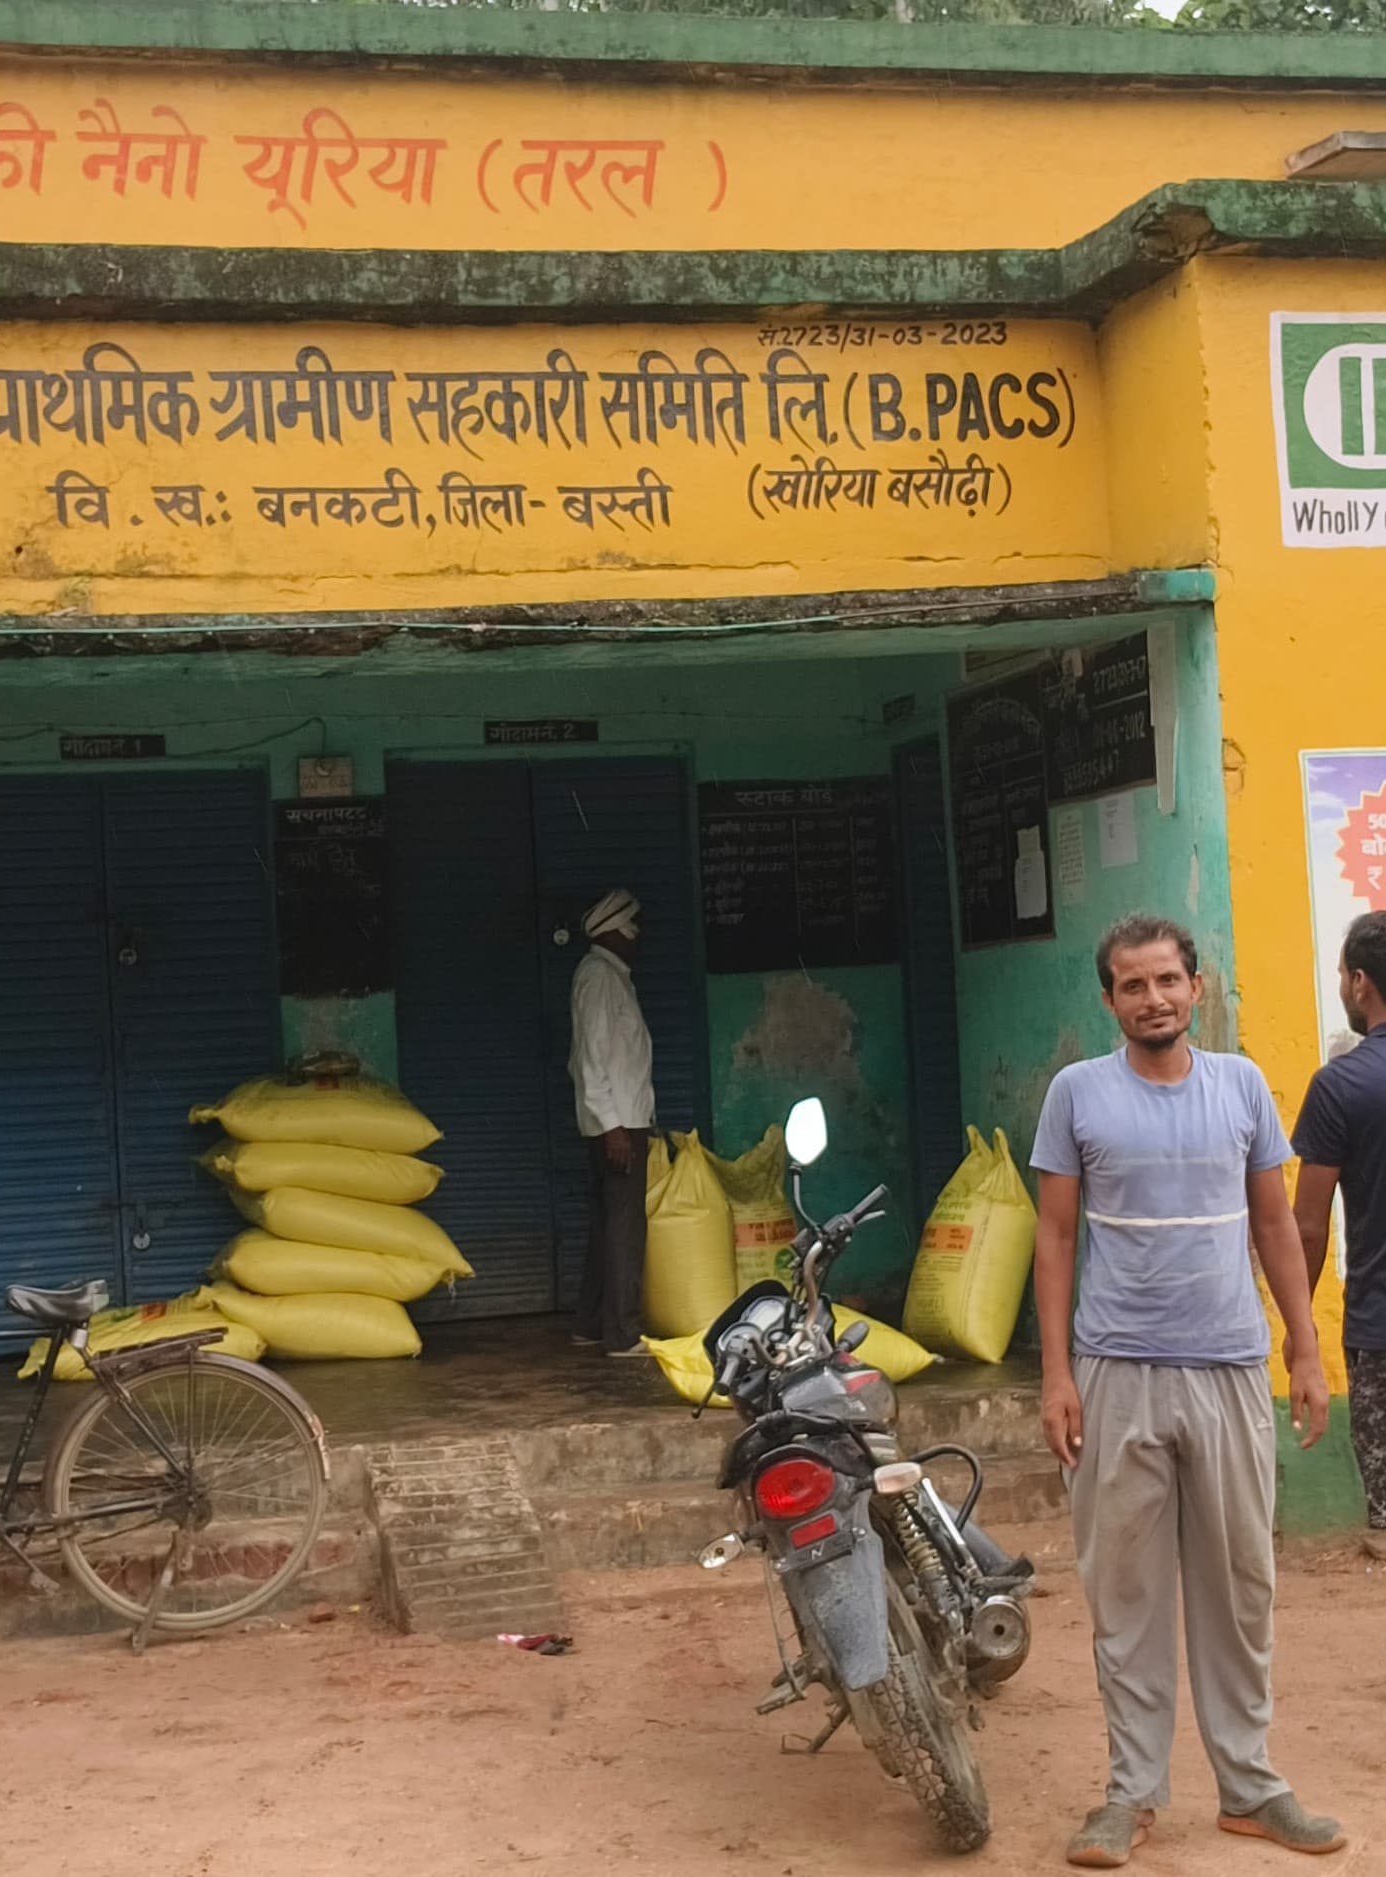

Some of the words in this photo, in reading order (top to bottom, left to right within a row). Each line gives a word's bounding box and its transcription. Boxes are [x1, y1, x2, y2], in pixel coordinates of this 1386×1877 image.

[76, 97, 207, 198] नैनो
[234, 107, 448, 231] यूरिया
[210, 345, 396, 446] ग्रामीण
[405, 349, 588, 461] सहकारी
[598, 349, 749, 456] समिति
[558, 467, 674, 531] बस्ती
